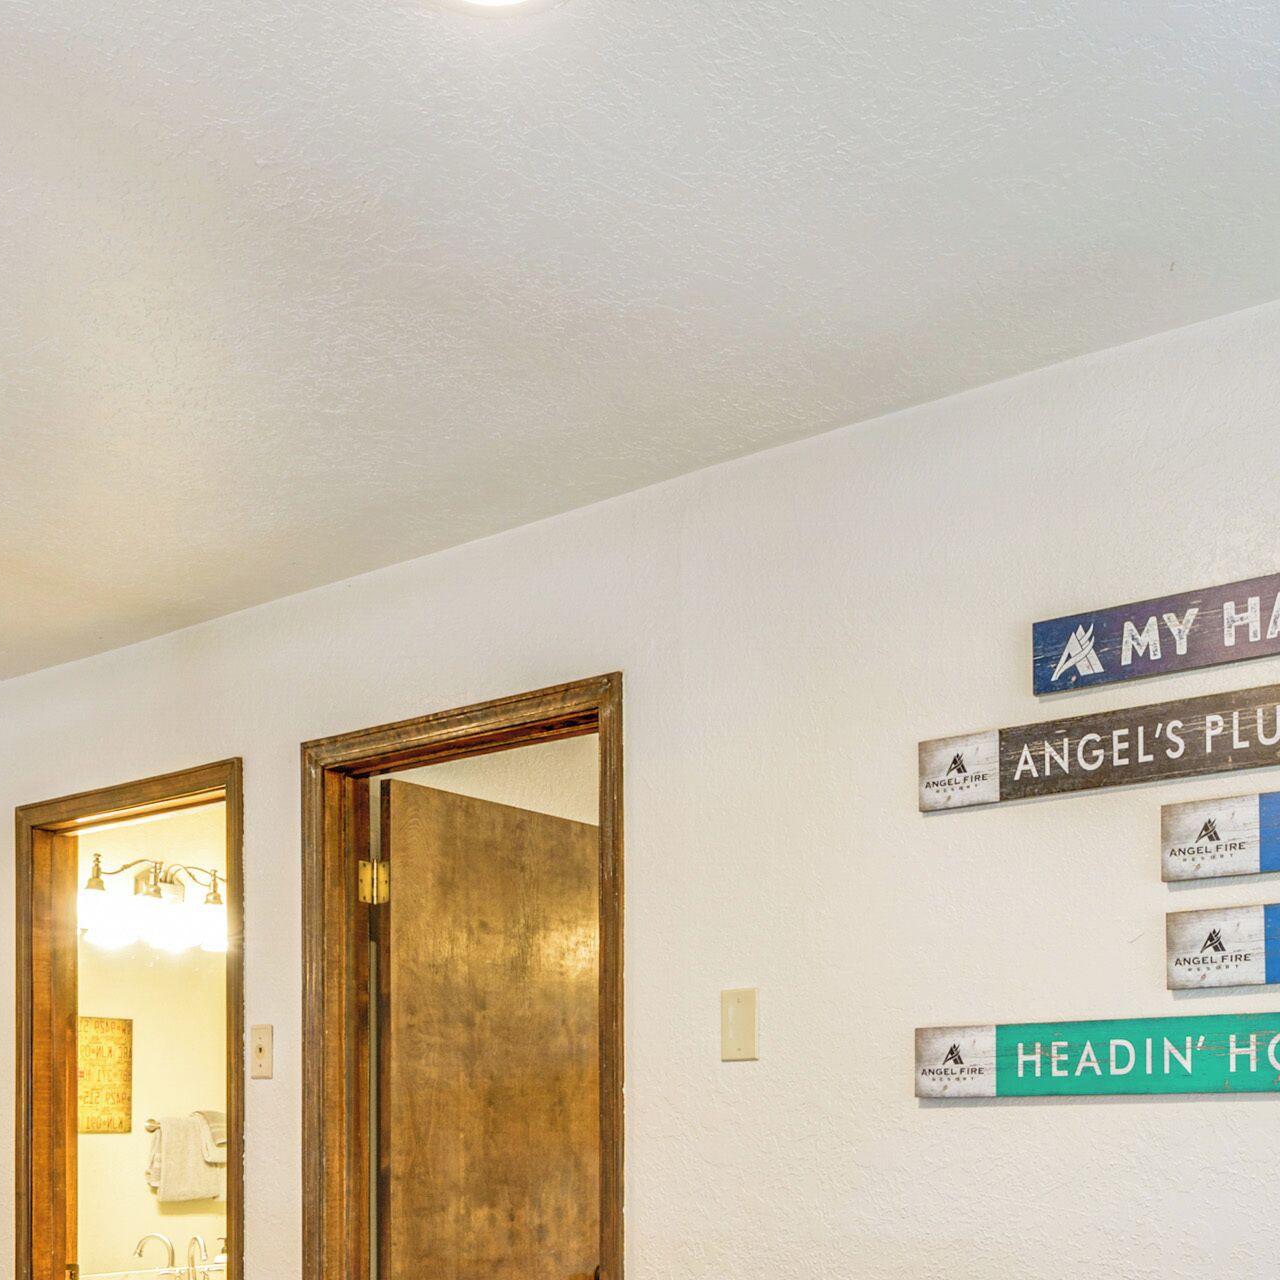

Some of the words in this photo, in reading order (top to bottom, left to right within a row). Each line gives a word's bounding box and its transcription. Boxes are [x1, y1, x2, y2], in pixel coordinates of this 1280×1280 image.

[1121, 607, 1199, 666] MY
[1013, 719, 1186, 781] ANGEL'S
[925, 777, 960, 789] ANGEL
[963, 773, 989, 783] FIRE
[1169, 846, 1212, 858] ANGEL
[1216, 842, 1246, 853] FIRE
[1174, 956, 1218, 967] ANGEL
[1221, 953, 1252, 963] FIRE
[1017, 1034, 1205, 1078] HEADIN'
[921, 1068, 957, 1076] ANGEL
[960, 1067, 985, 1075] FIRE
